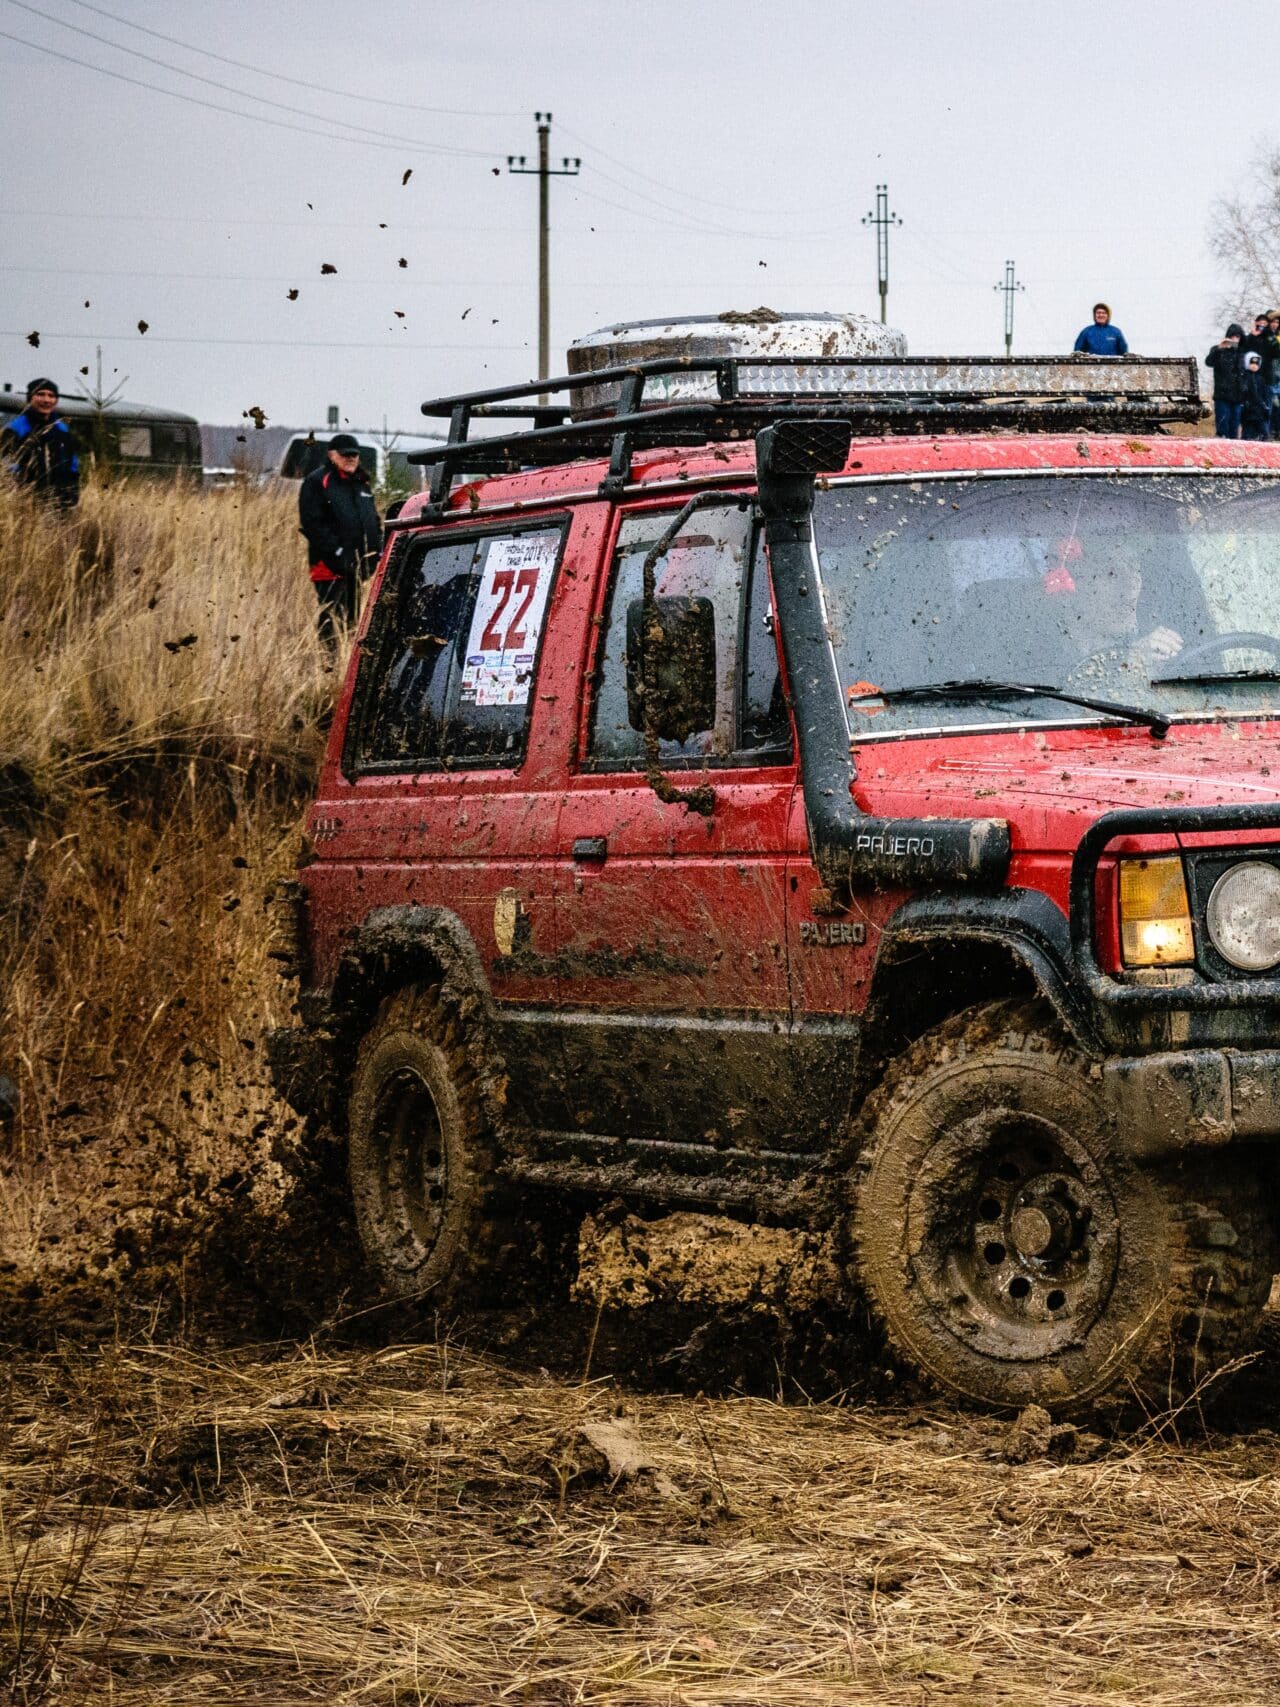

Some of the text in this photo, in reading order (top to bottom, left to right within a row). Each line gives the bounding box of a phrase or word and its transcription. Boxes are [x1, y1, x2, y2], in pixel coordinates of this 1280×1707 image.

[480, 568, 540, 651] 22
[857, 835, 934, 856] PAJERO
[799, 922, 866, 947] PAJERO
